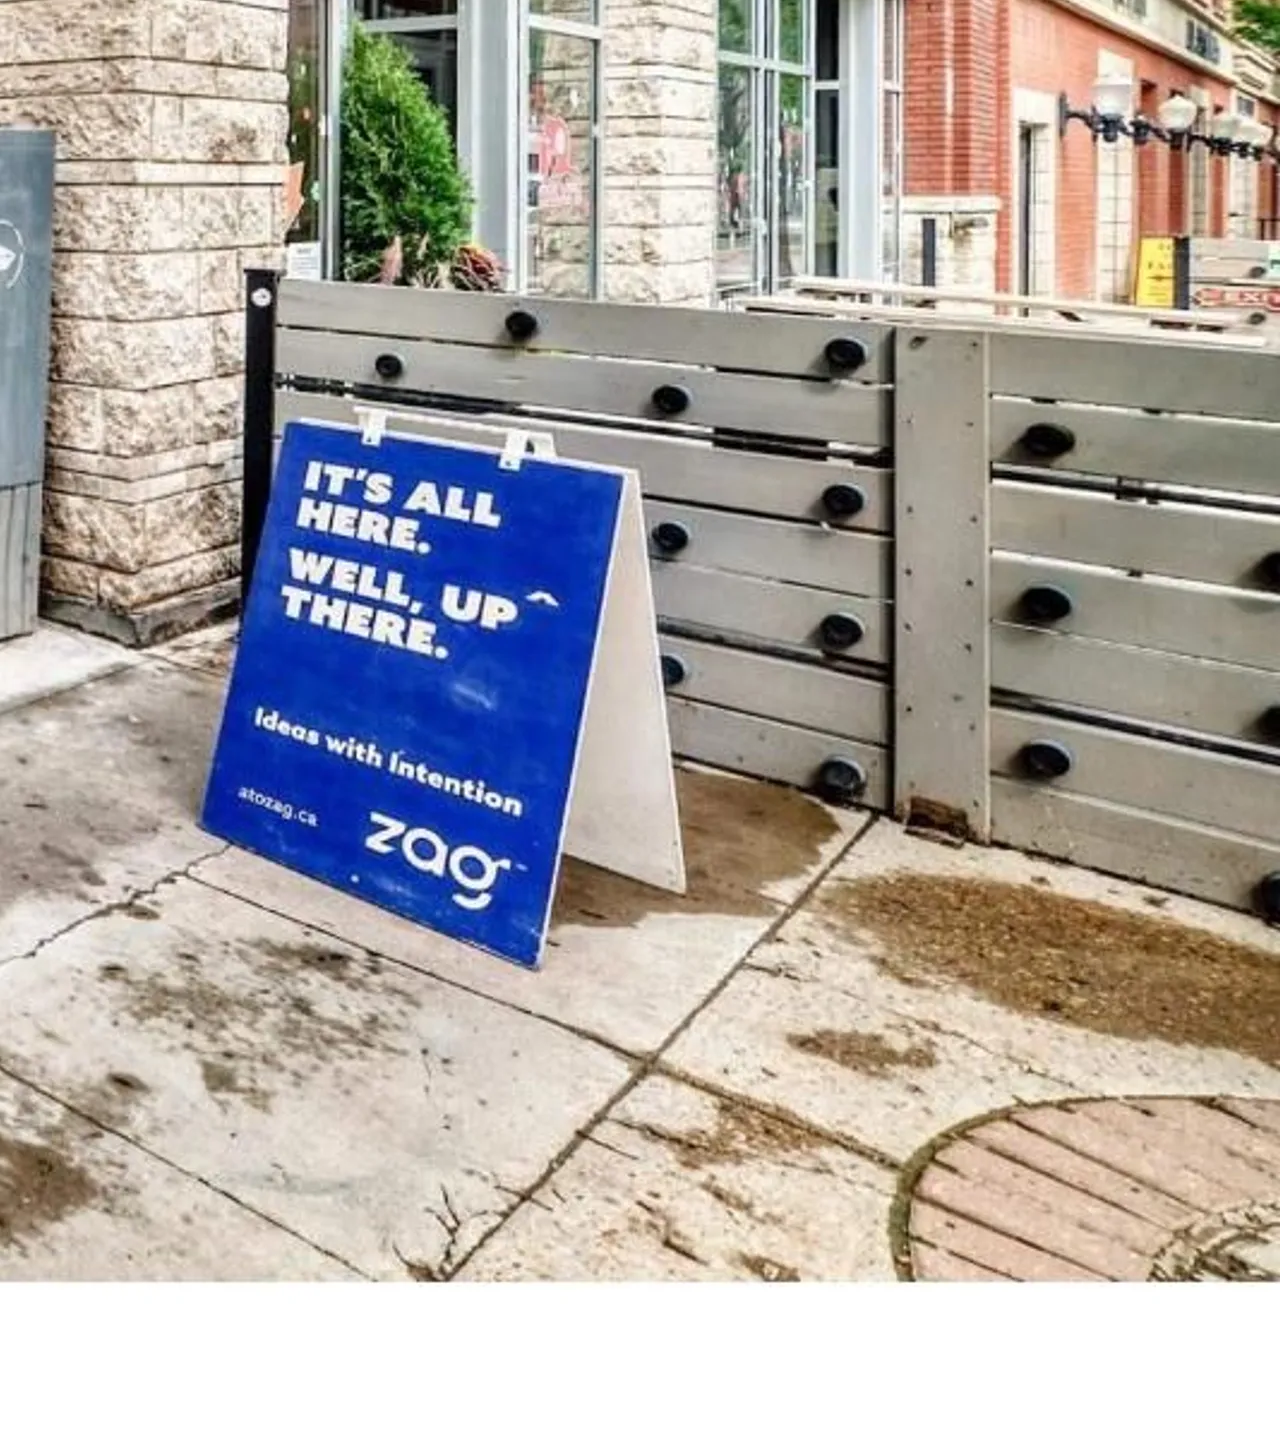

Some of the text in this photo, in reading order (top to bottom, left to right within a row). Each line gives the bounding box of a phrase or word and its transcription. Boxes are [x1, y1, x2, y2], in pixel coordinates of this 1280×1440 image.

[295, 497, 431, 555] HERE.
[303, 460, 502, 528] IT'S ALL
[280, 584, 449, 660] THERE.
[288, 547, 519, 630] WELL, UP
[254, 706, 523, 817] Ideas with Intention
[238, 786, 319, 827] atozag.ca
[364, 811, 512, 910] zag
